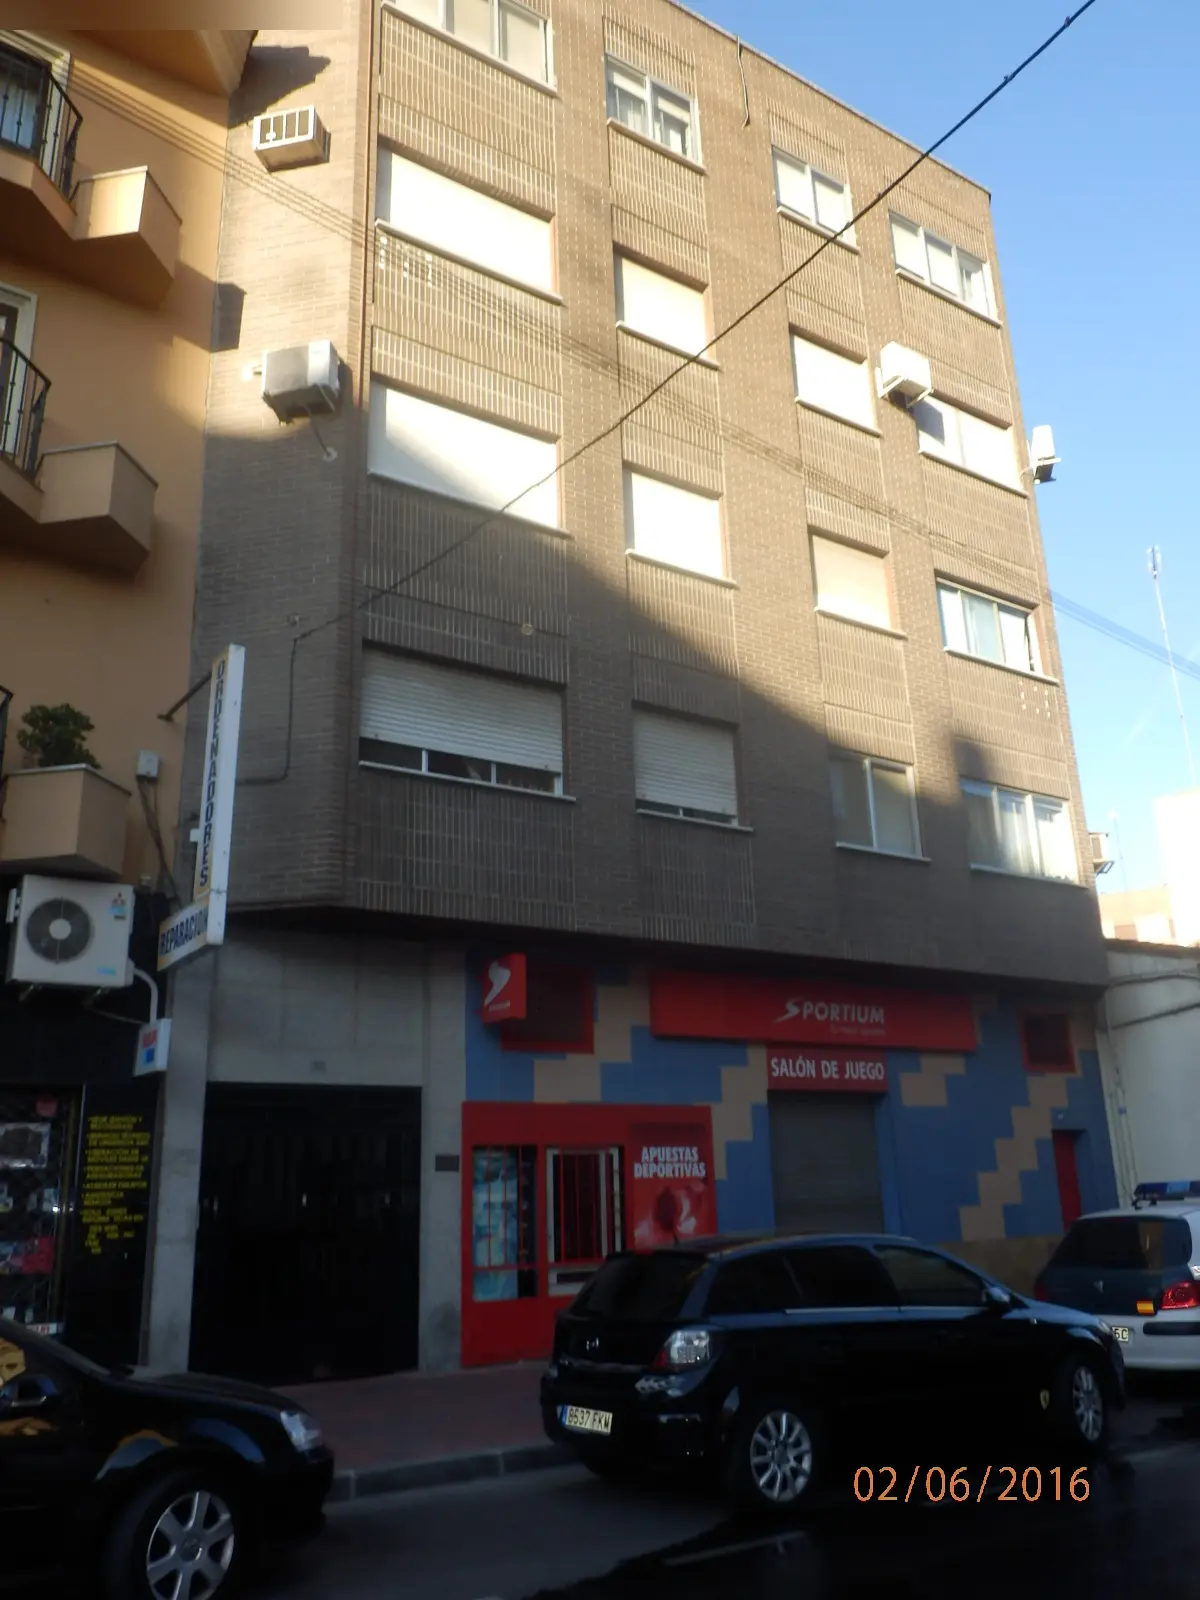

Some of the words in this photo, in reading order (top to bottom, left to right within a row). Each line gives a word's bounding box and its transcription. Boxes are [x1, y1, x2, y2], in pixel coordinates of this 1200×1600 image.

[200, 659, 225, 886] ORDENADORES
[773, 997, 884, 1024] SPORTIUM
[771, 1055, 815, 1079] SALÓN
[821, 1060, 840, 1080] DE
[844, 1060, 885, 1081] JUEGO
[641, 1145, 699, 1163] APUESTAS
[634, 1161, 706, 1179] DEPORTIVAS
